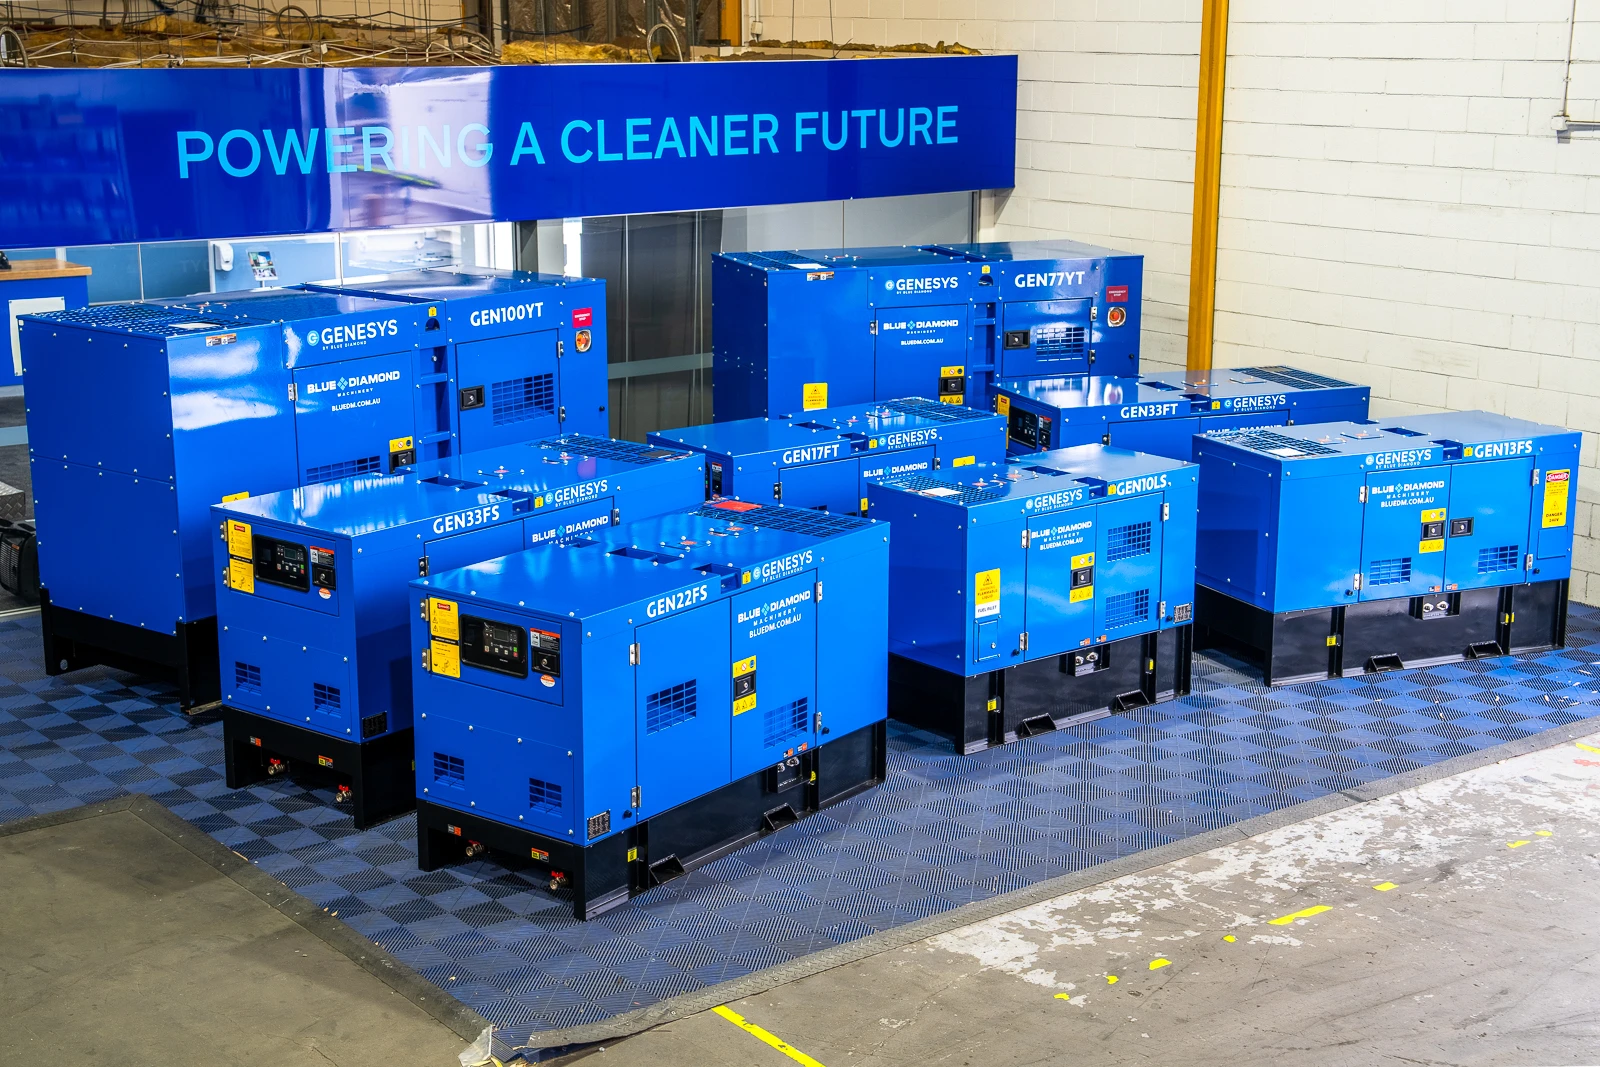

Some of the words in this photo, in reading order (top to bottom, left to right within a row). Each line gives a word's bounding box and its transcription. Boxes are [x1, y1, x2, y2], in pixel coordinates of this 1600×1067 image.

[177, 123, 494, 179] POWERING
[509, 122, 546, 166] A
[561, 113, 779, 163] CLEANER
[796, 105, 958, 152] FUTURE
[896, 276, 958, 291] GENESYS
[1015, 271, 1085, 288] GEN77YT
[470, 302, 544, 327] GEN100YT
[321, 319, 398, 344] GENESYS
[883, 322, 906, 330] BLUE
[916, 320, 958, 329] DIAMOND
[345, 340, 367, 348] DIAMOND
[307, 380, 336, 394] BLUE
[348, 370, 400, 388] DIAMOND
[338, 388, 374, 397] MACHINERY
[331, 398, 381, 412] BLUEDM.COM.AU
[1233, 395, 1286, 408] GENESYS
[1120, 404, 1178, 418] GEN33FT
[888, 429, 938, 445] GENESYS
[783, 444, 840, 464] GEN17FT
[1375, 449, 1432, 466] GENESYS
[1474, 440, 1533, 458] GEN13FS
[864, 468, 883, 478] BLUE
[892, 462, 928, 474] DIAMOND
[555, 480, 608, 502] GENESYS
[1117, 474, 1168, 496] GEN10LS
[1372, 485, 1394, 495] BLUE
[1404, 480, 1445, 491] DIAMOND
[577, 494, 598, 503] DIAMOND
[1034, 489, 1083, 508] GENESYS
[1380, 497, 1434, 508] BLUEDM.COM.AU
[1386, 491, 1429, 499] MACHINERY
[433, 505, 499, 534] GEN33FS
[532, 529, 556, 543] BLUE
[566, 515, 608, 534] DIAMOND
[1032, 528, 1051, 539] BLUE
[1058, 521, 1092, 534] DIAMOND
[1044, 531, 1080, 542] MACHINERY
[1040, 537, 1083, 550] BLUEDM.COM.AU
[762, 550, 813, 577] GENESYS
[770, 573, 781, 581] BLUE
[783, 566, 803, 577] DIAMOND
[646, 585, 708, 618] GEN22FS
[738, 607, 761, 623] BLUE
[770, 590, 810, 612] DIAMOND
[753, 607, 797, 626] MACHINERY
[749, 614, 802, 638] BLUEDM.COM.AU
